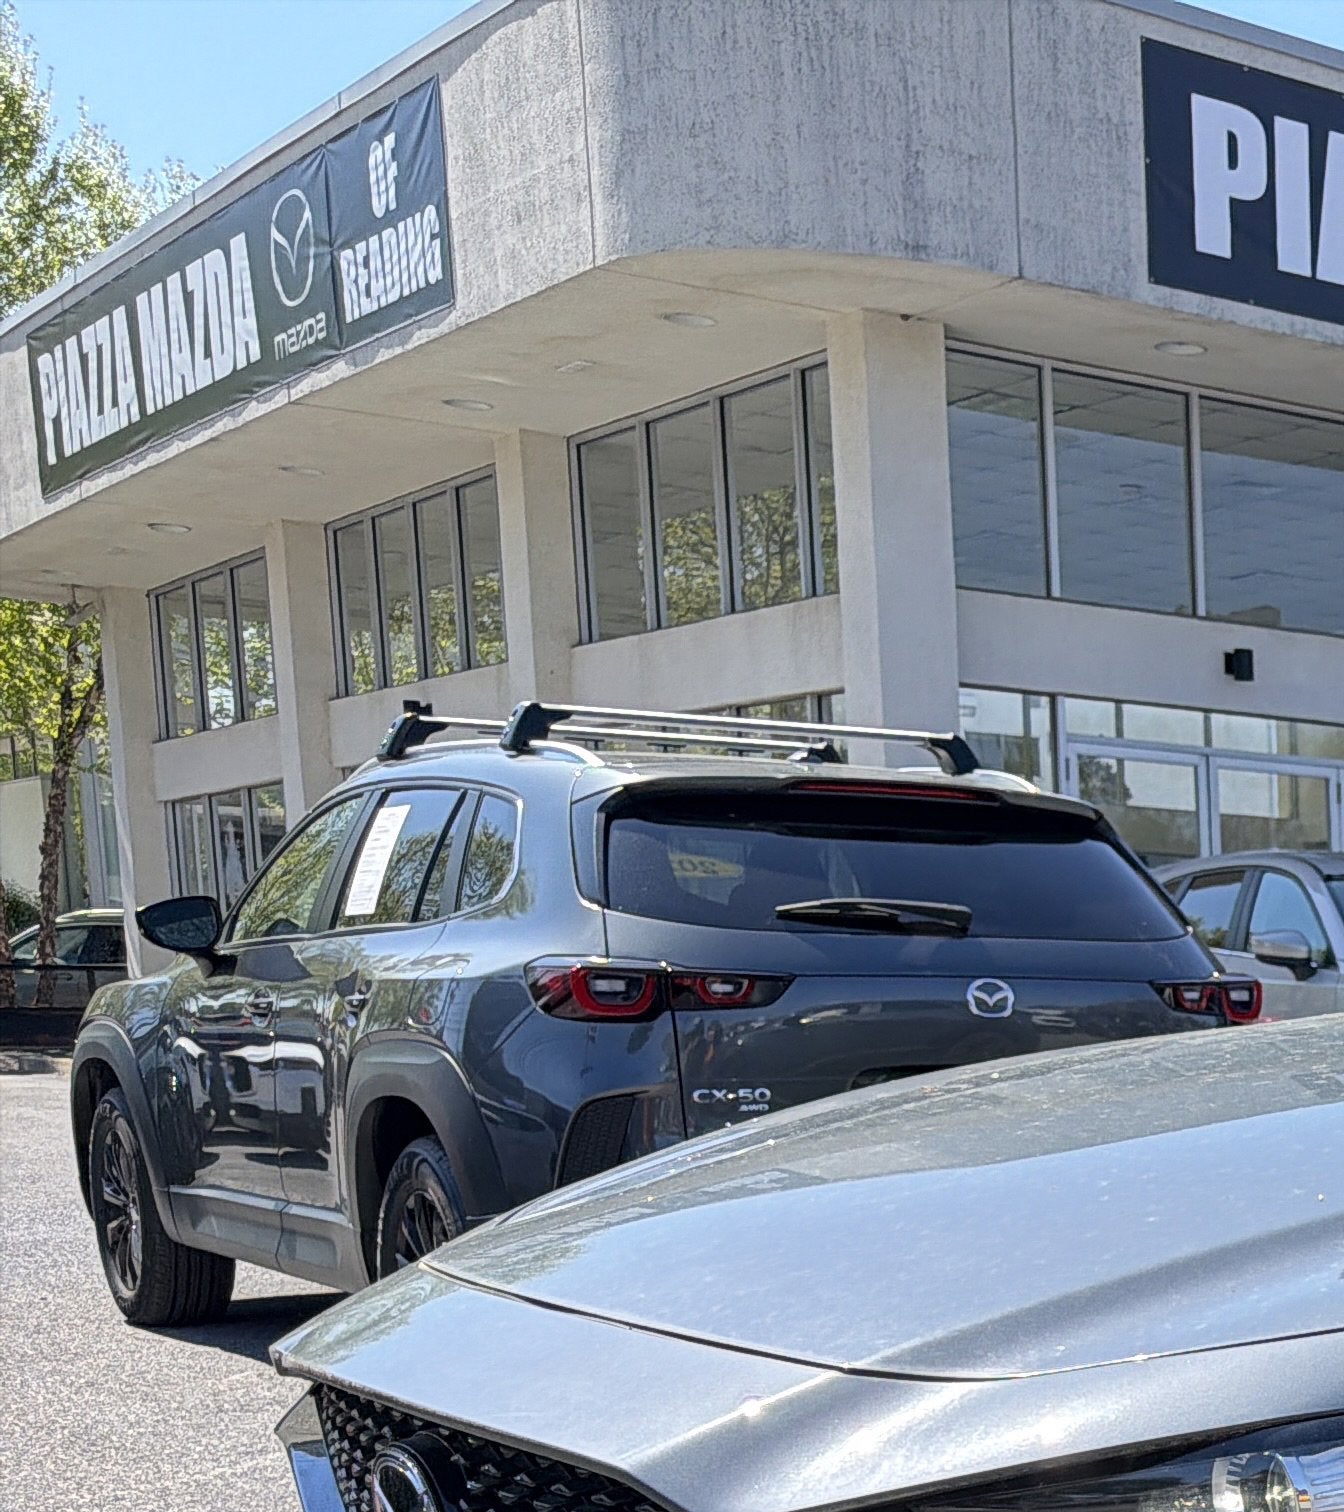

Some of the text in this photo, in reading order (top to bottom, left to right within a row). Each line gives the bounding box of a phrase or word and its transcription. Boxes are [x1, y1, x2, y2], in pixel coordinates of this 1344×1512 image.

[367, 132, 397, 218] OF
[339, 204, 443, 324] READING
[36, 231, 261, 466] PIAZZA MAZDA
[692, 1087, 772, 1104] CX-50
